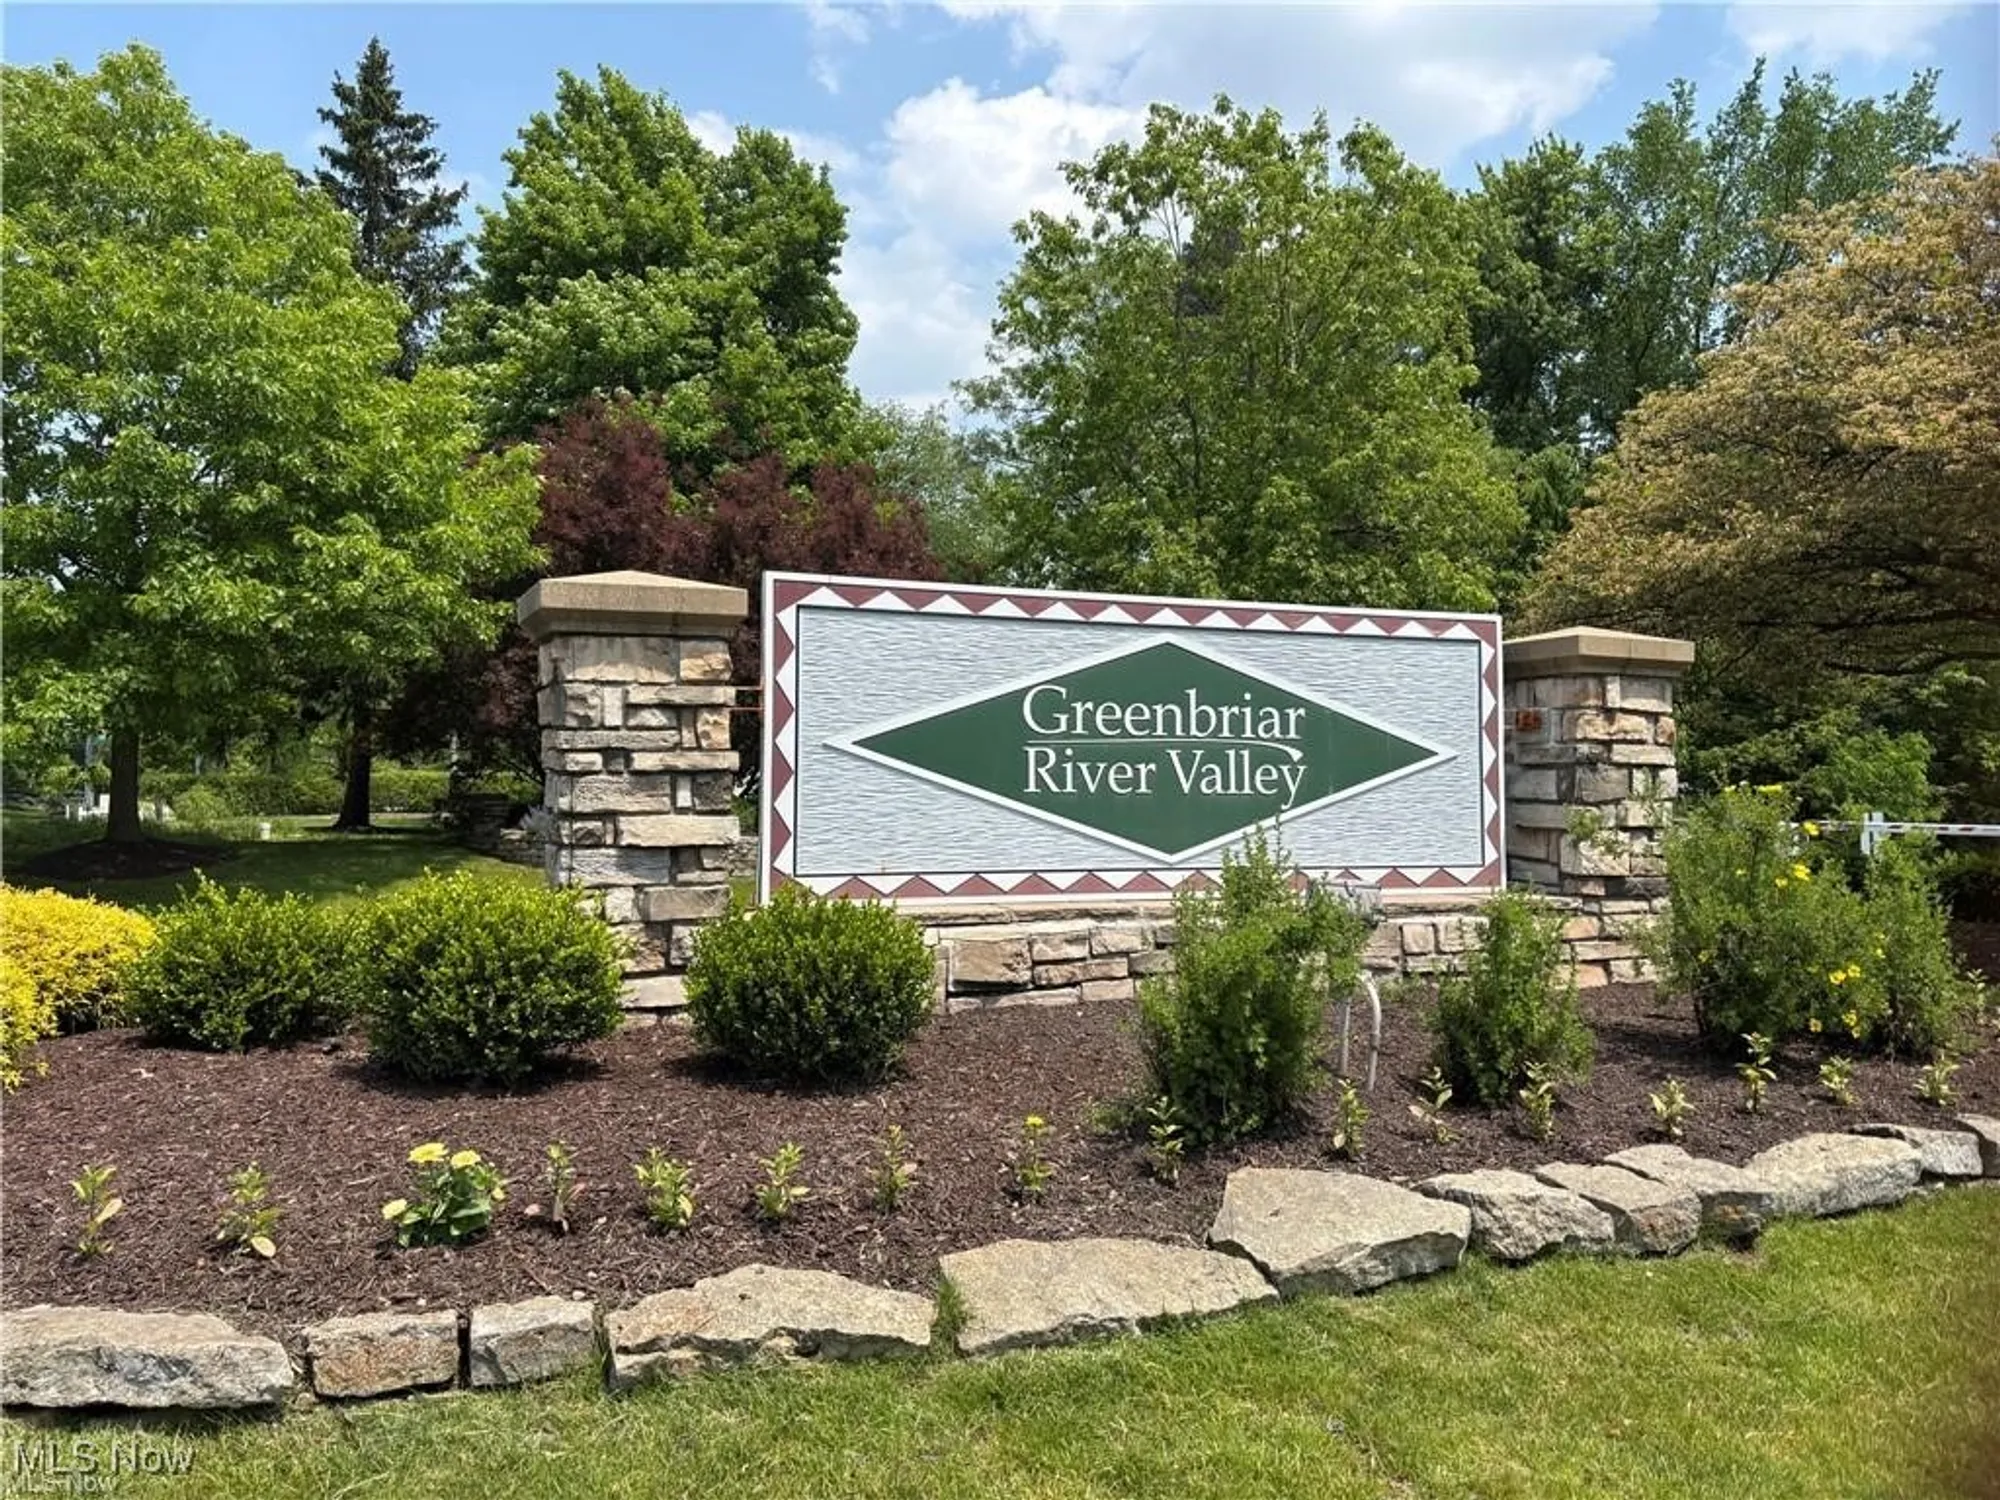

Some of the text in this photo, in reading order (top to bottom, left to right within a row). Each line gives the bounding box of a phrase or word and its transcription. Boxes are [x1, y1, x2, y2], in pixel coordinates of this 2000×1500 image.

[1022, 684, 1306, 740] Greenbriar
[1023, 746, 1307, 810] River Valley
